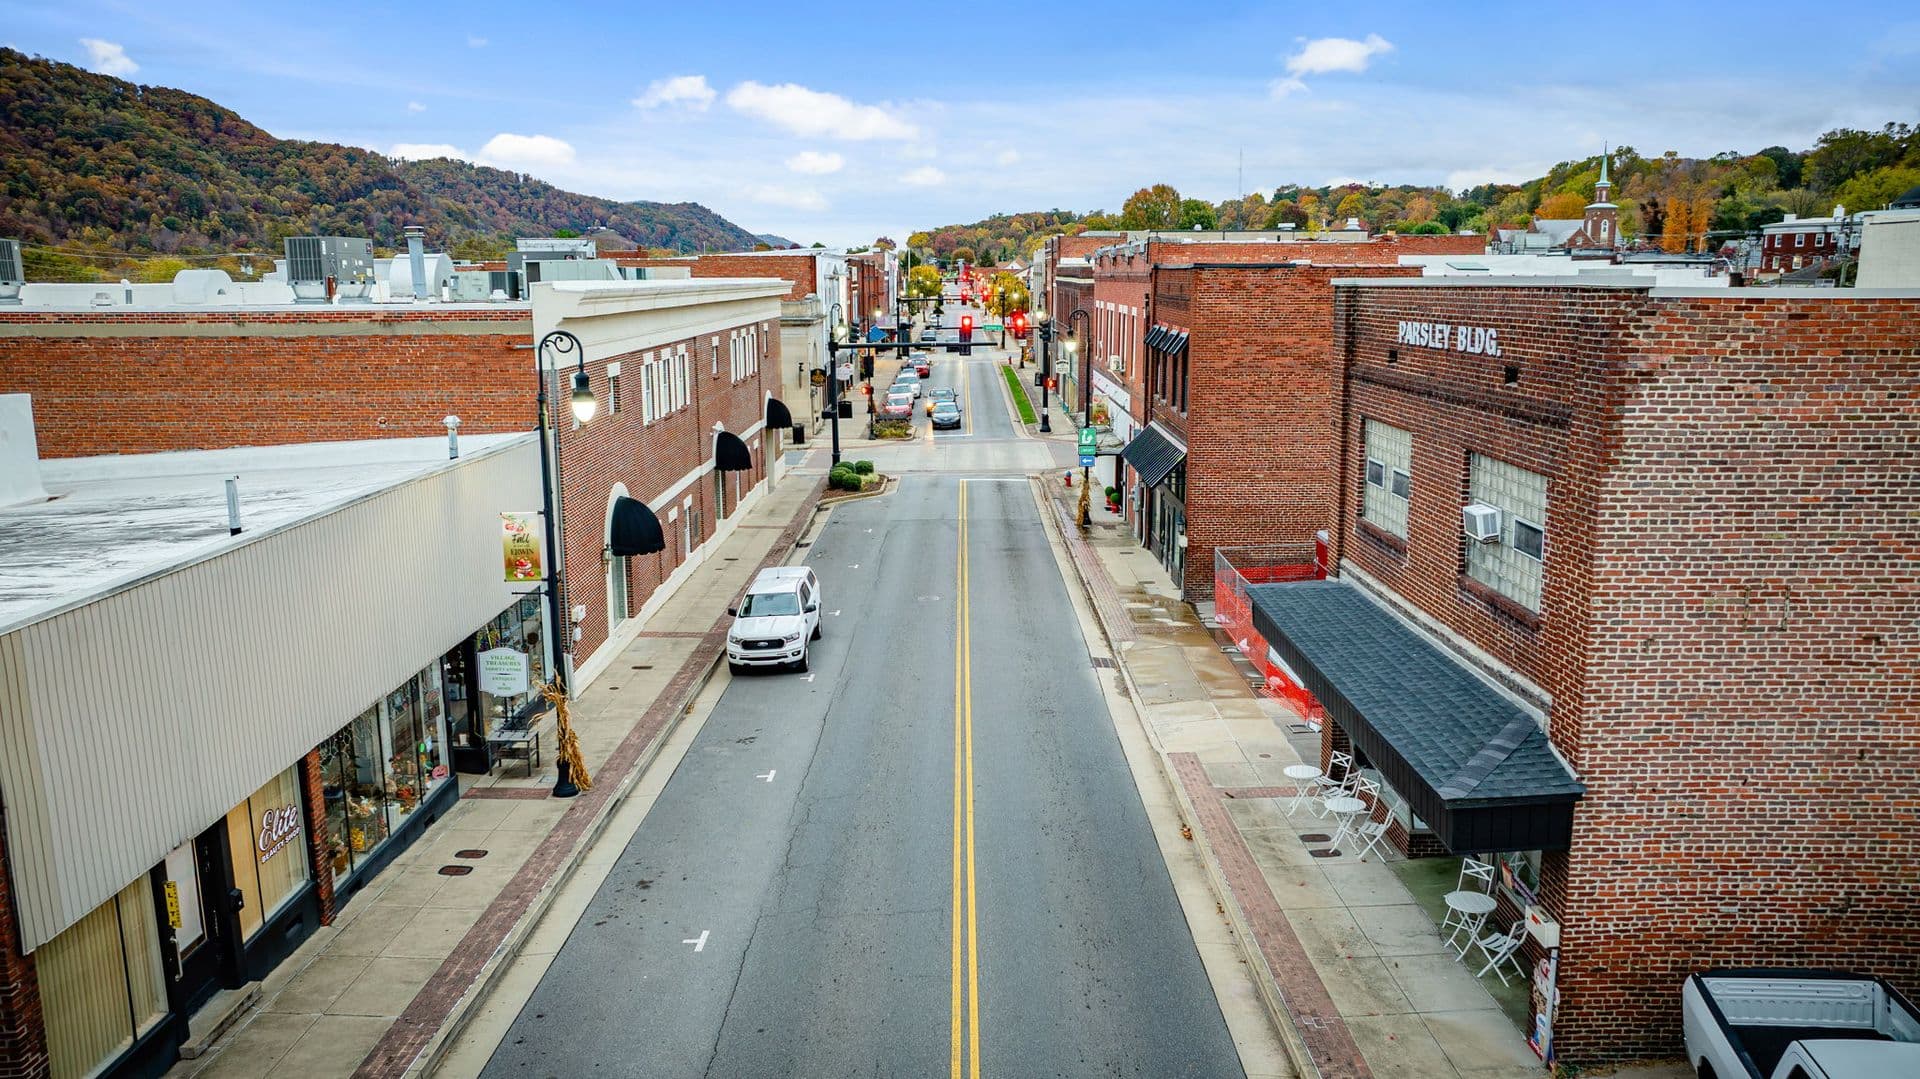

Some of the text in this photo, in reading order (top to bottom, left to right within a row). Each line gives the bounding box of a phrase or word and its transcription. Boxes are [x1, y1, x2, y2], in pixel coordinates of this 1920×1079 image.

[1398, 320, 1502, 357] PARSLEY BLDG.
[511, 533, 529, 544] Fall
[259, 803, 298, 852] Elite
[261, 825, 302, 864] BEAUTY SHOP
